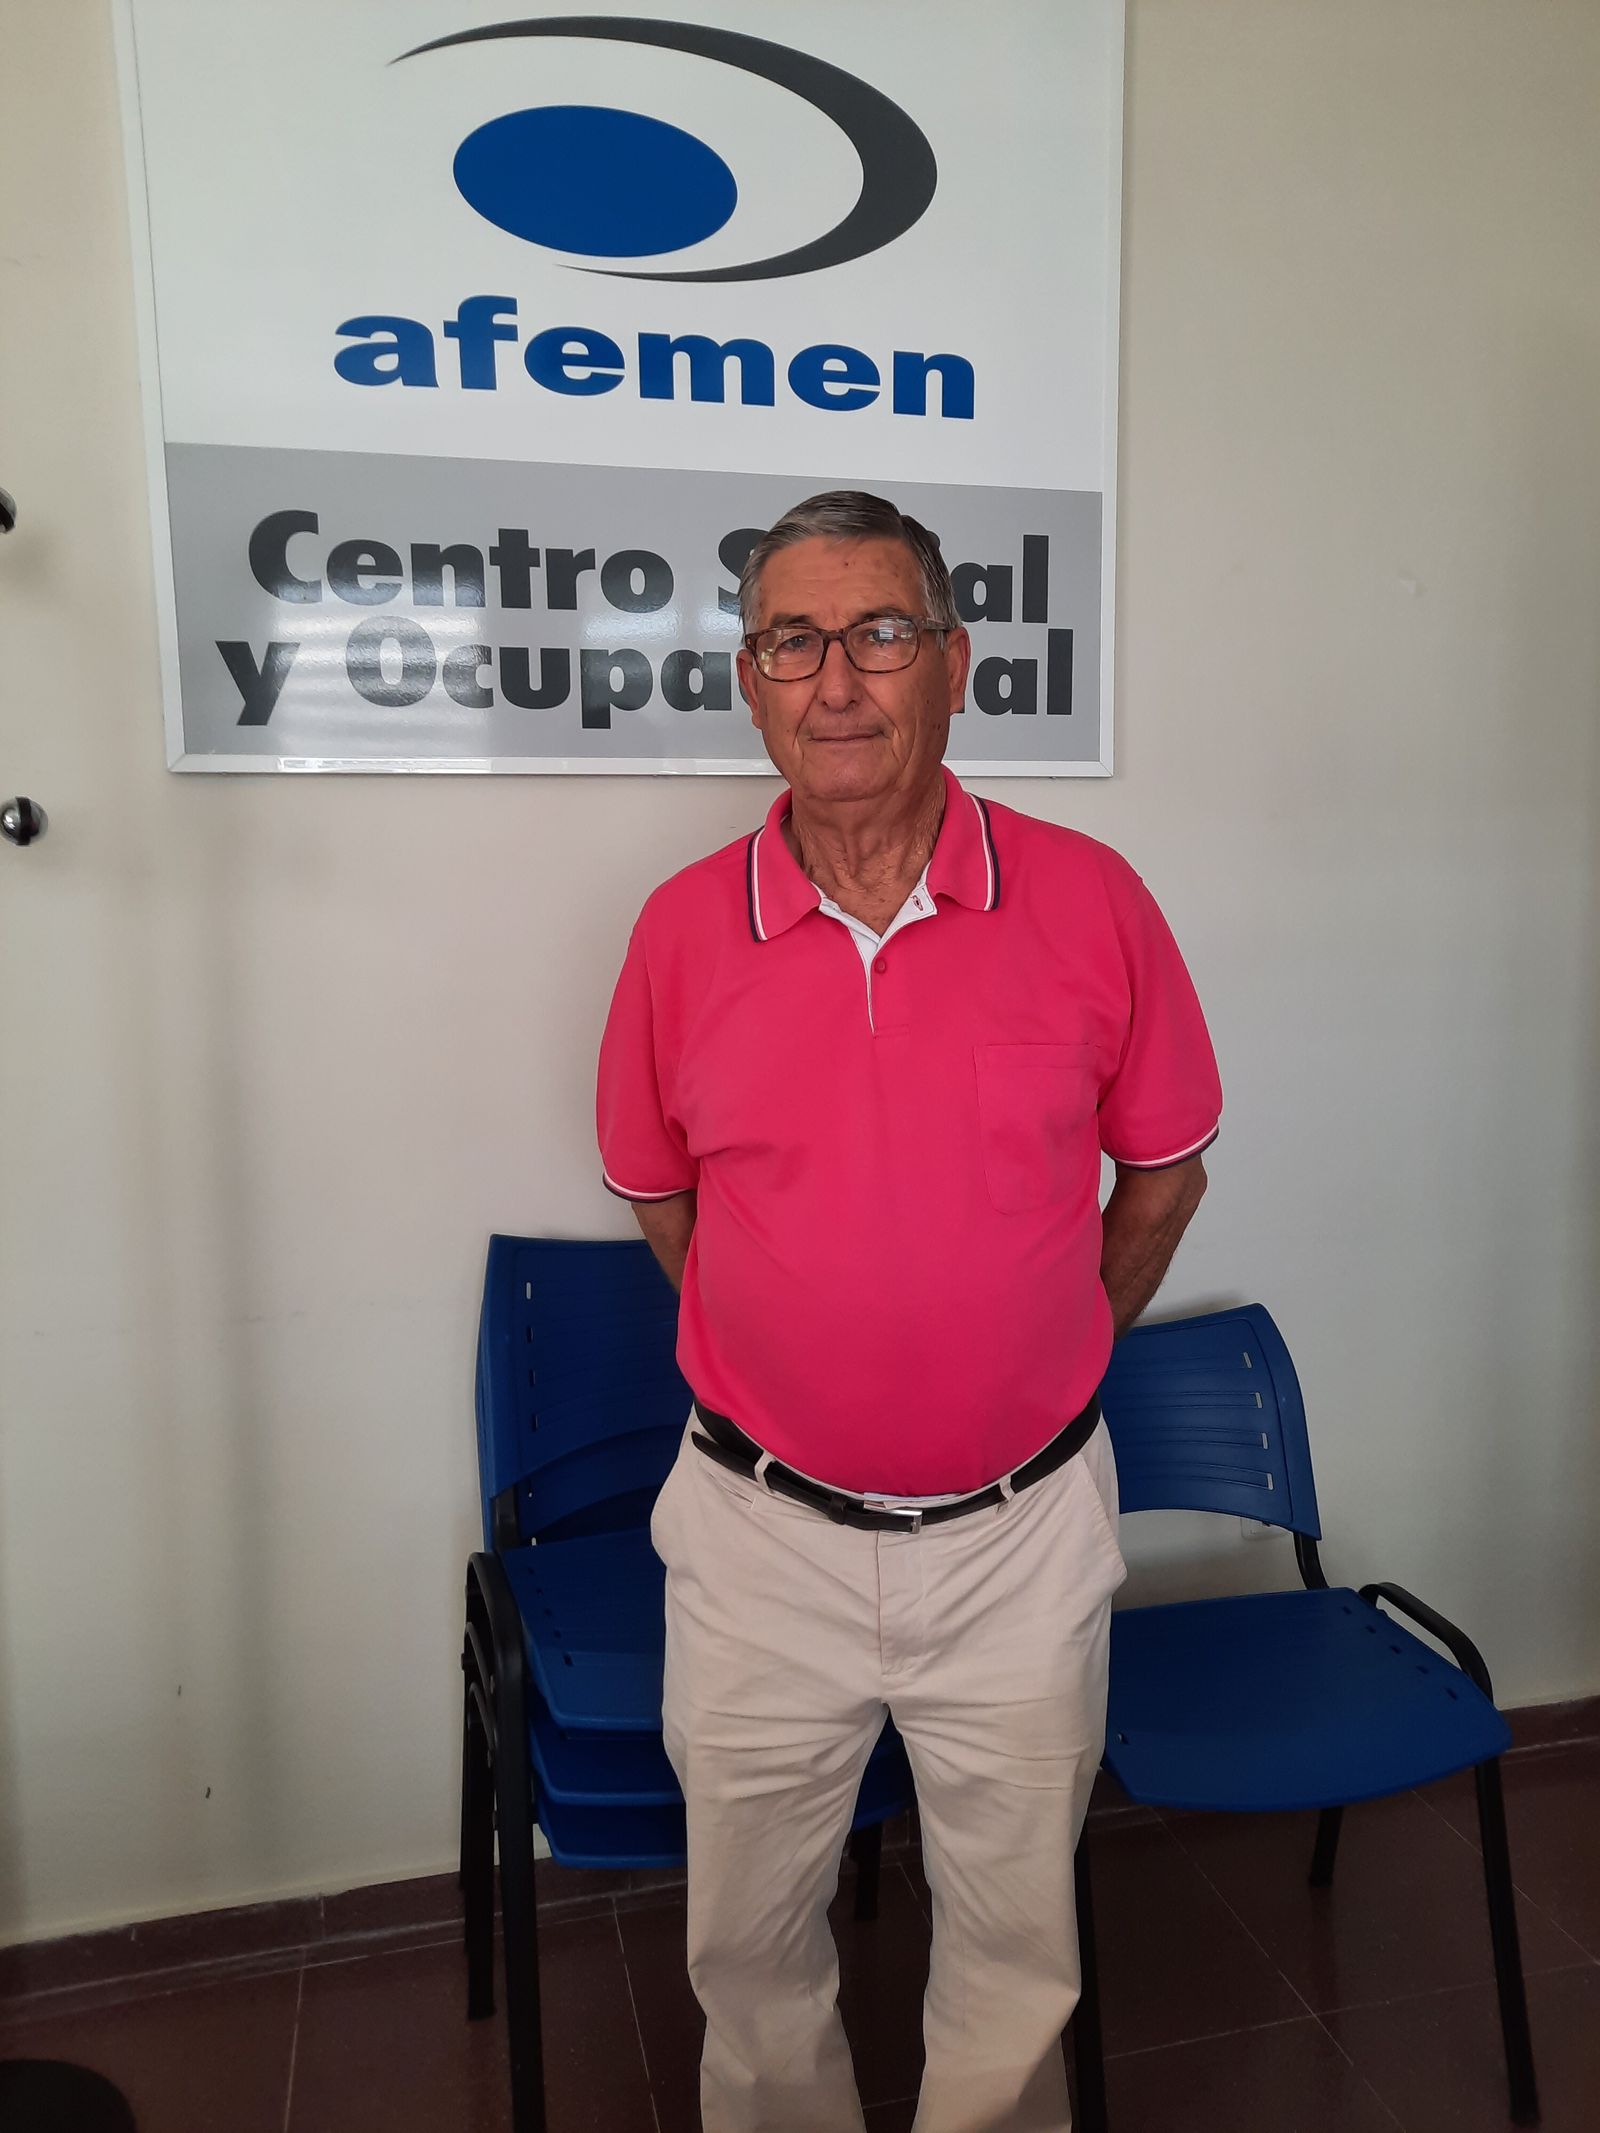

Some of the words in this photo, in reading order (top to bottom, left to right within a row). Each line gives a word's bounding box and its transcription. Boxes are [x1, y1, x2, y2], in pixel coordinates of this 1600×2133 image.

[334, 295, 975, 419] afemen
[248, 510, 674, 614] Centro
[215, 640, 301, 726] y
[345, 615, 1073, 729] Ocupaal
